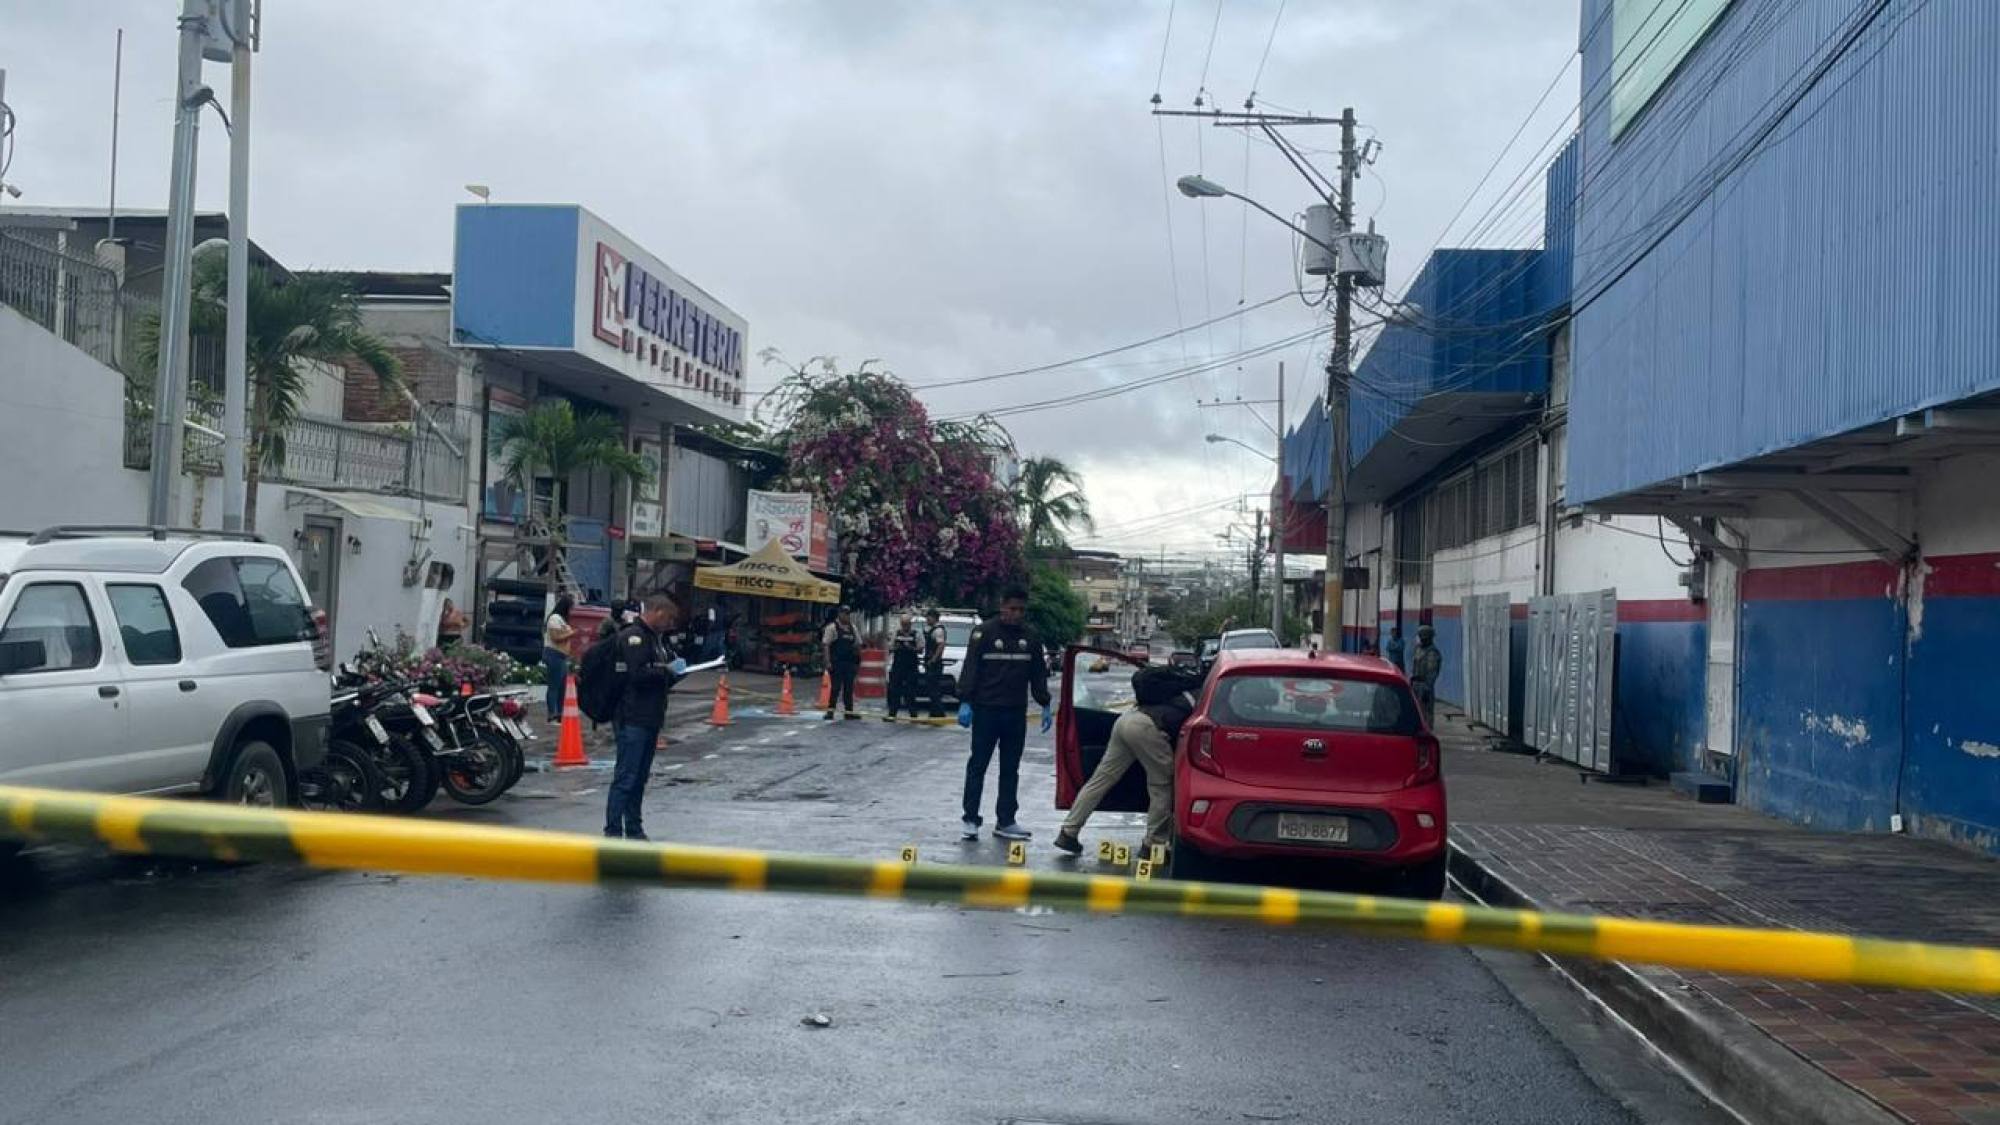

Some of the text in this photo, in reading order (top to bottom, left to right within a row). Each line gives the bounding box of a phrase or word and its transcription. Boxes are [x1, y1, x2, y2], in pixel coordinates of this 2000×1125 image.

[624, 262, 742, 379] FERRETERIA
[1012, 844, 1021, 857] 4
[1101, 841, 1110, 854] 2
[1117, 847, 1126, 860] 3
[902, 848, 912, 862] 6
[1139, 863, 1149, 876] 5
